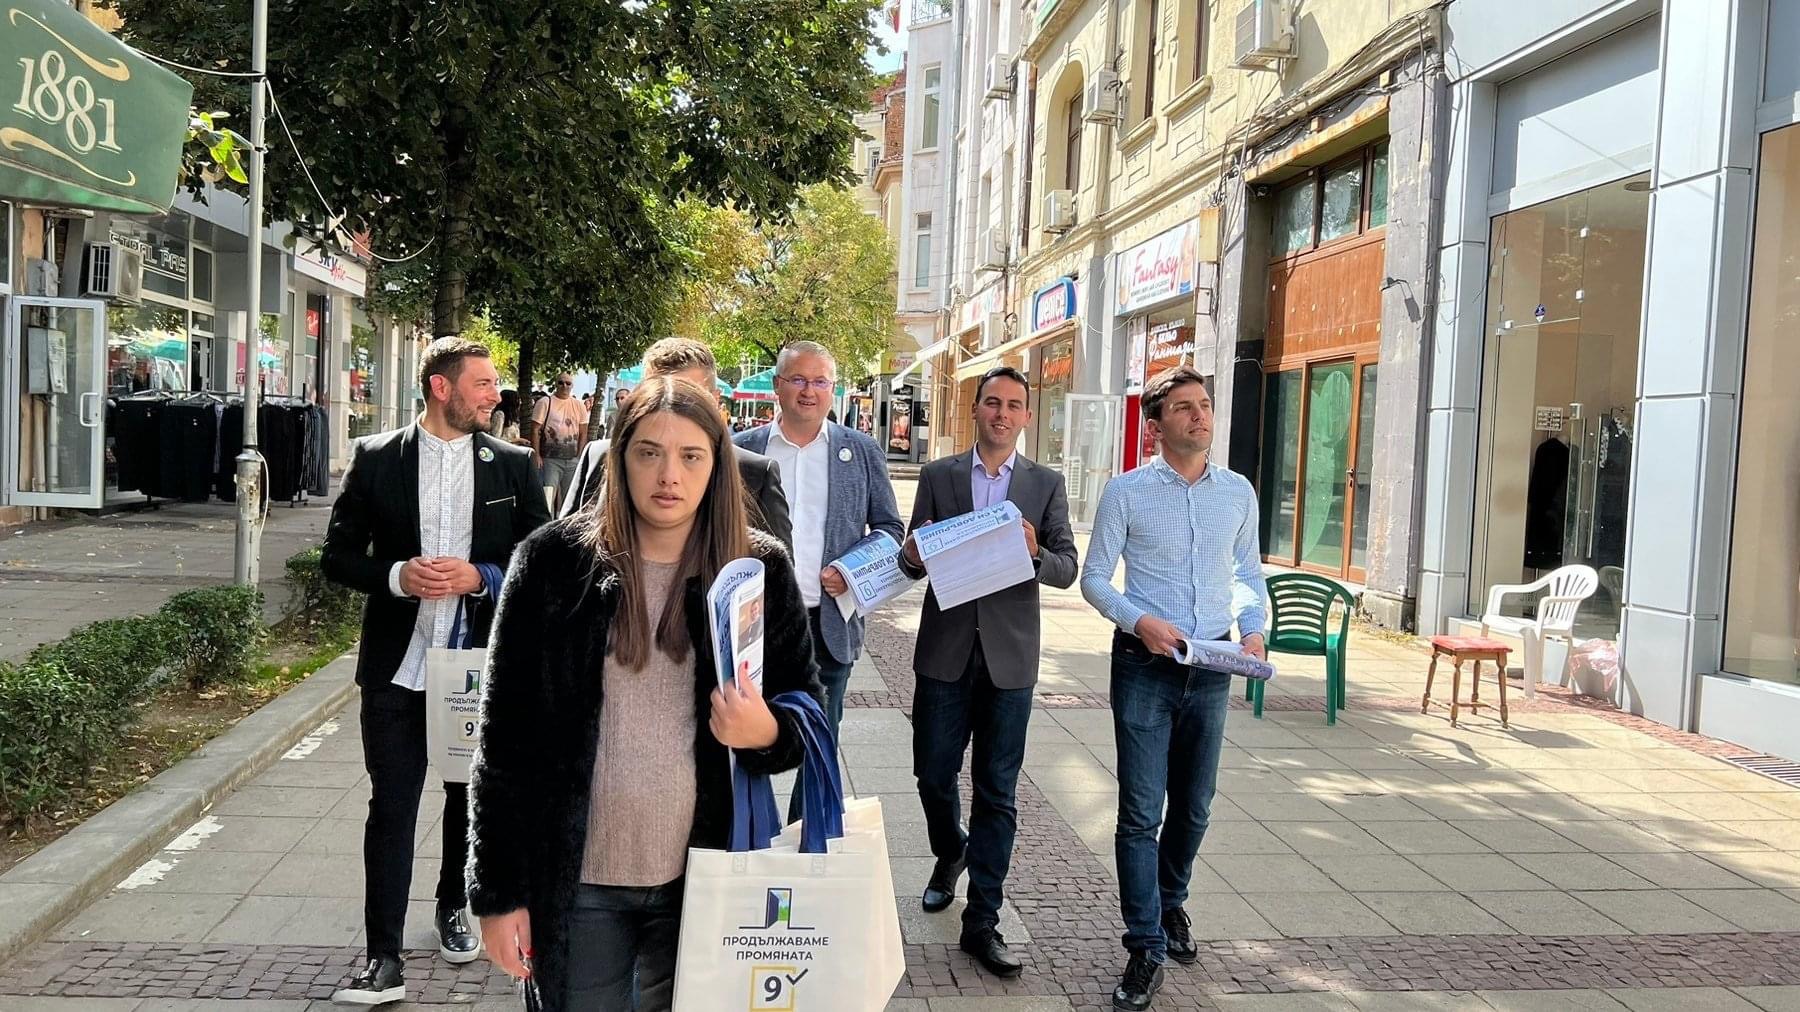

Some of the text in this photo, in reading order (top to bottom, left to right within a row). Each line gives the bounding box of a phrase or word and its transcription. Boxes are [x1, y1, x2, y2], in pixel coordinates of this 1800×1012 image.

[12, 50, 123, 153] 1881
[1132, 242, 1179, 290] Fantasy
[464, 721, 475, 737] 9
[722, 936, 830, 947] ПРОДЪЛЖАВАМЕ
[736, 950, 814, 961] ПРОМЯНАТА
[764, 975, 782, 1002] 9
